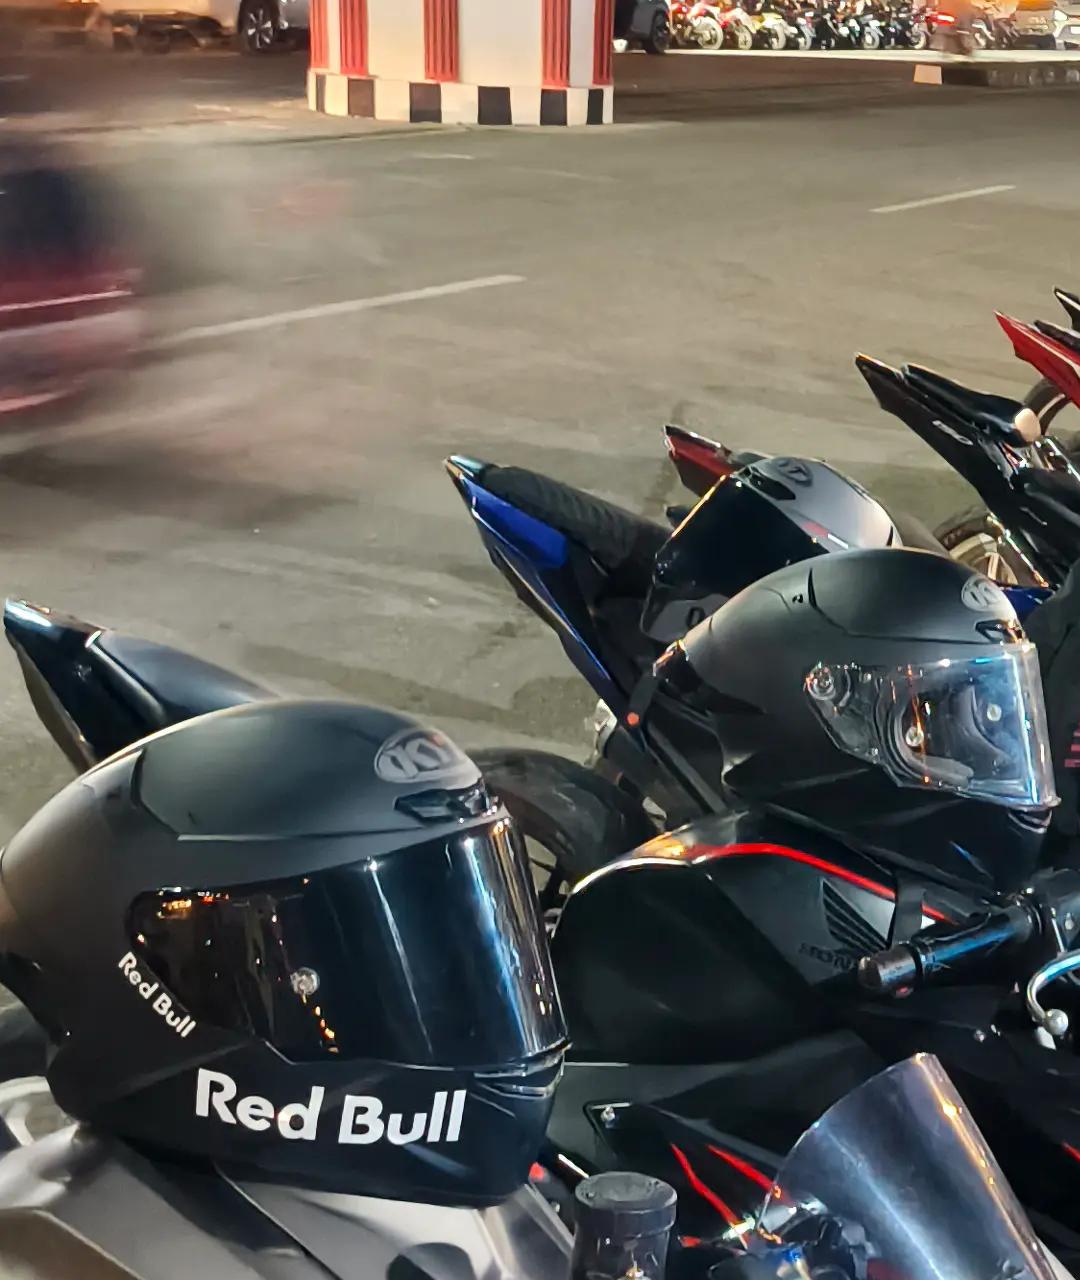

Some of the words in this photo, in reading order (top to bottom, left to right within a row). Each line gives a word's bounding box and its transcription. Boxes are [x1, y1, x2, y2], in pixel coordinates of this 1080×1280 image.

[119, 951, 160, 1000] Red
[152, 992, 197, 1038] Bull
[196, 1068, 325, 1141] Red
[338, 1089, 467, 1145] Bull
